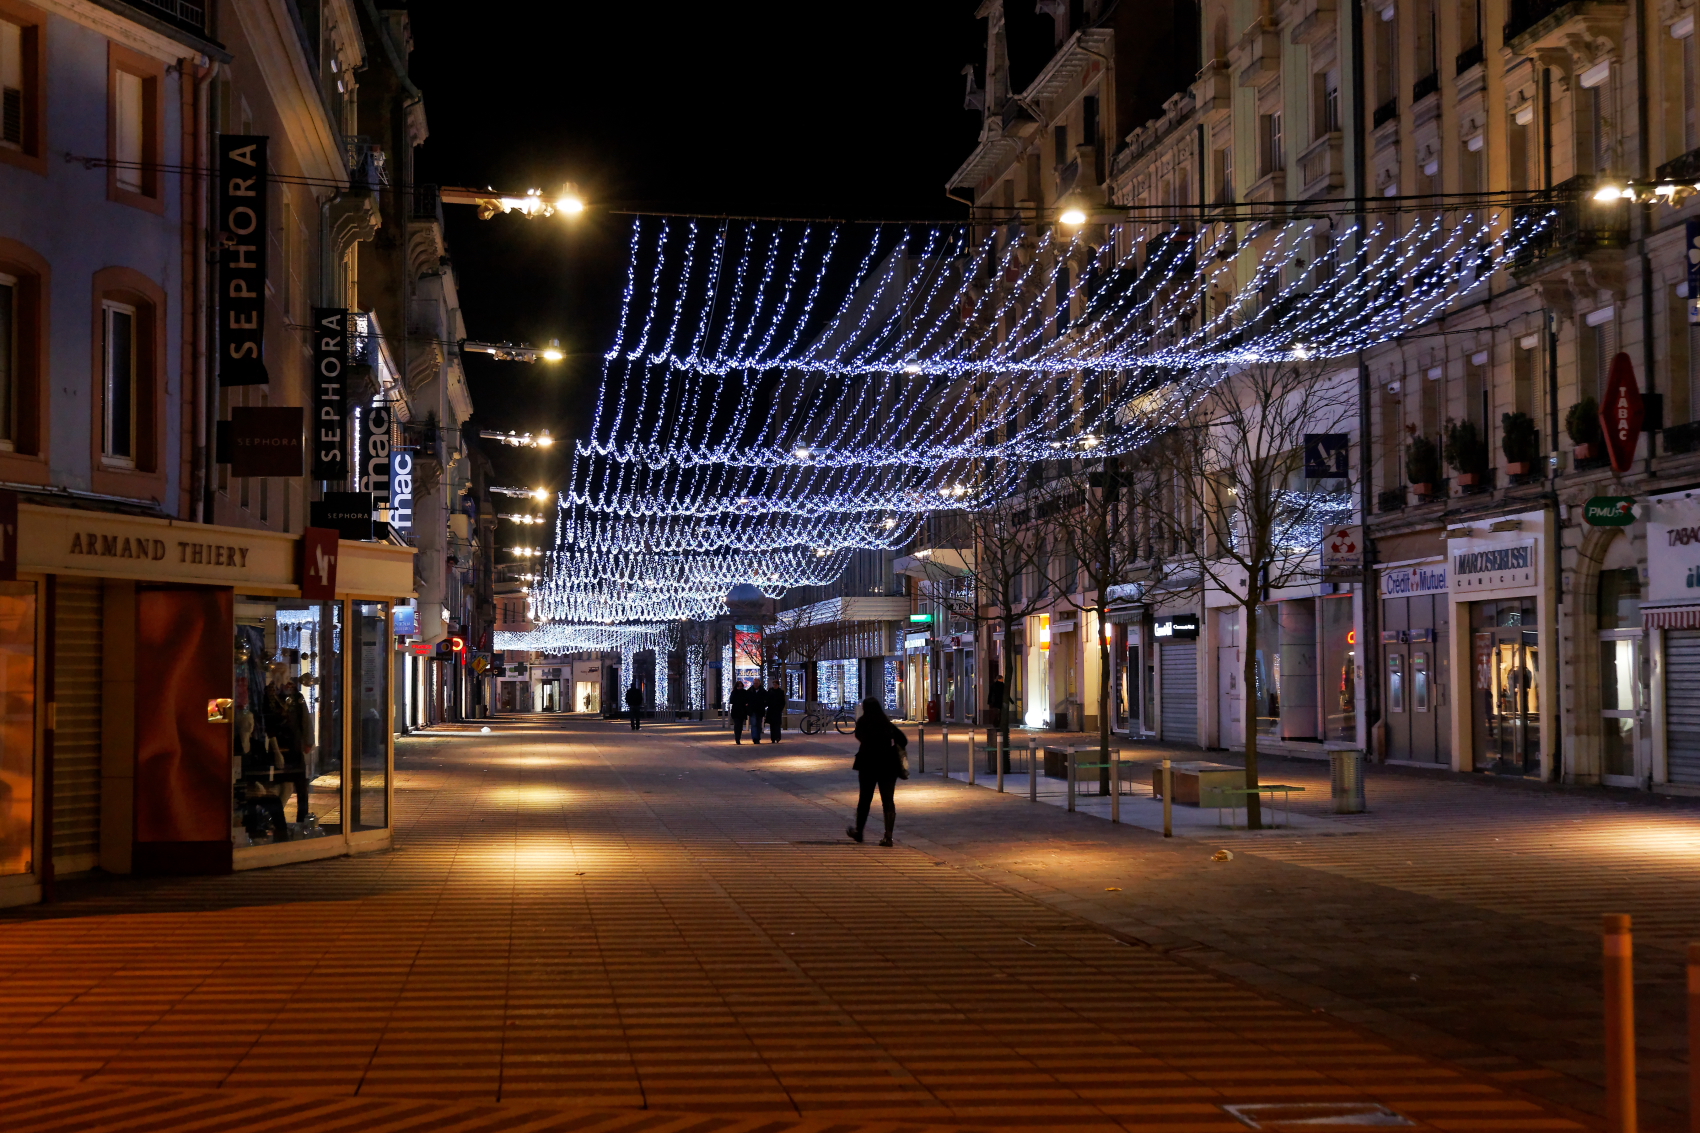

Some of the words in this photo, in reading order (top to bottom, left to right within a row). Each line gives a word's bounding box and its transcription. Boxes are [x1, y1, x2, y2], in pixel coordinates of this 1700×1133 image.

[228, 143, 258, 360] SEPHORA
[321, 313, 341, 462] SEPHORA
[1617, 386, 1629, 440] TABAC
[237, 437, 298, 447] SEPHORA
[361, 408, 390, 498] fnac
[389, 453, 413, 530] fnac
[1588, 506, 1614, 518] PMU
[327, 512, 369, 520] SEPHORA
[69, 532, 167, 561] ARMAND
[178, 541, 250, 569] THIERY
[1387, 573, 1411, 595] Crédit
[1419, 569, 1447, 591] Mutuel
